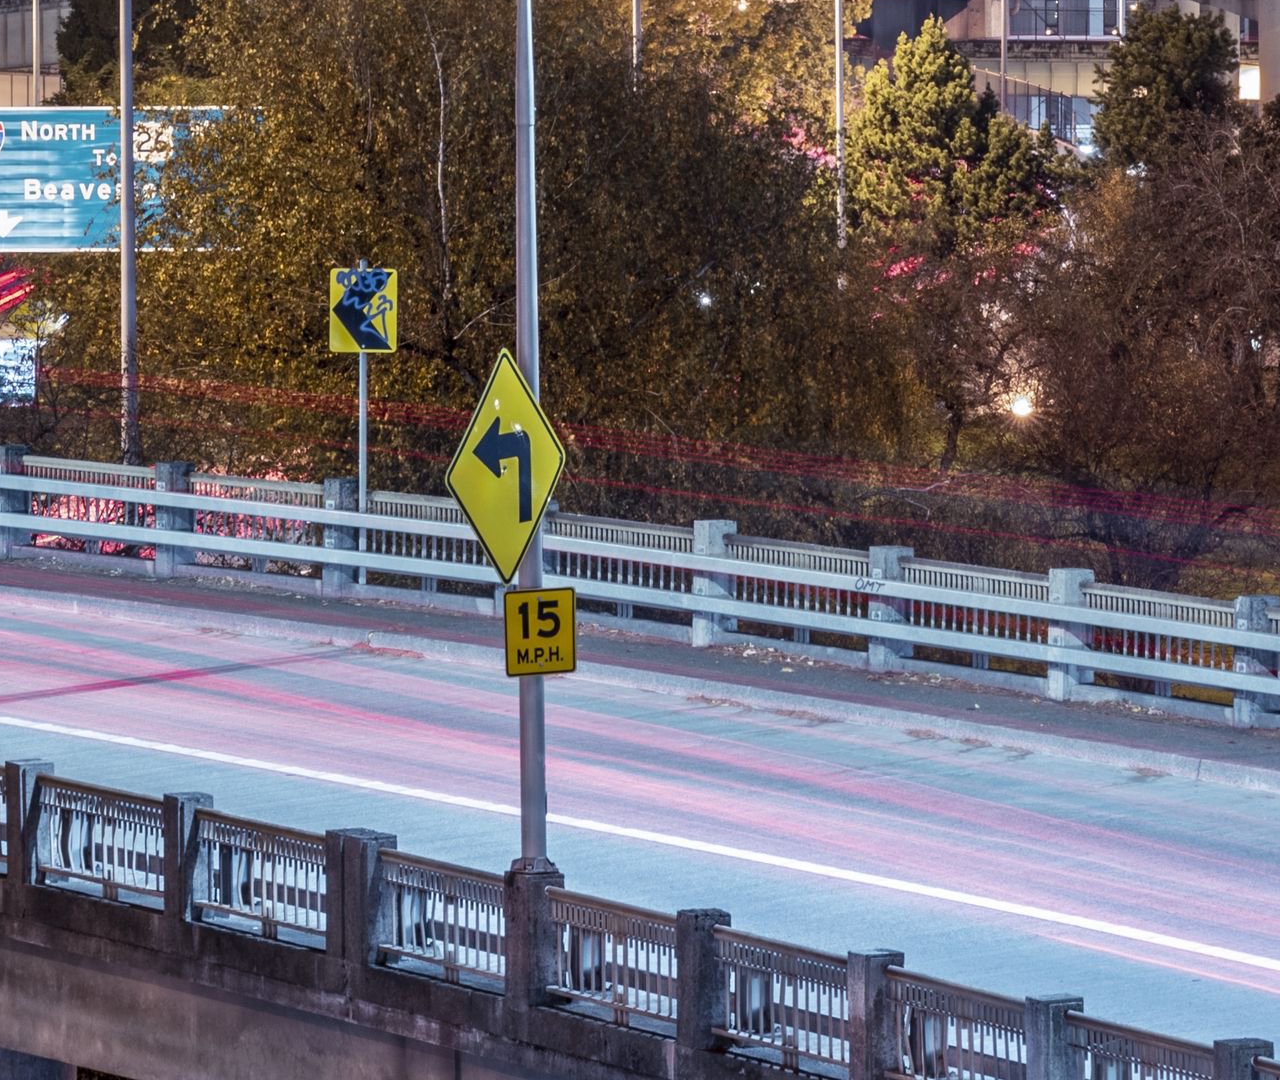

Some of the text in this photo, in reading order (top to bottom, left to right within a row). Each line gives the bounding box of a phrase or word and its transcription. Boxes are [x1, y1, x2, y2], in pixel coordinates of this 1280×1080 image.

[21, 121, 95, 141] NORTH
[93, 131, 168, 166] To 26
[855, 577, 886, 592] OMT
[518, 600, 560, 639] 15
[517, 646, 564, 664] M.P.H.
